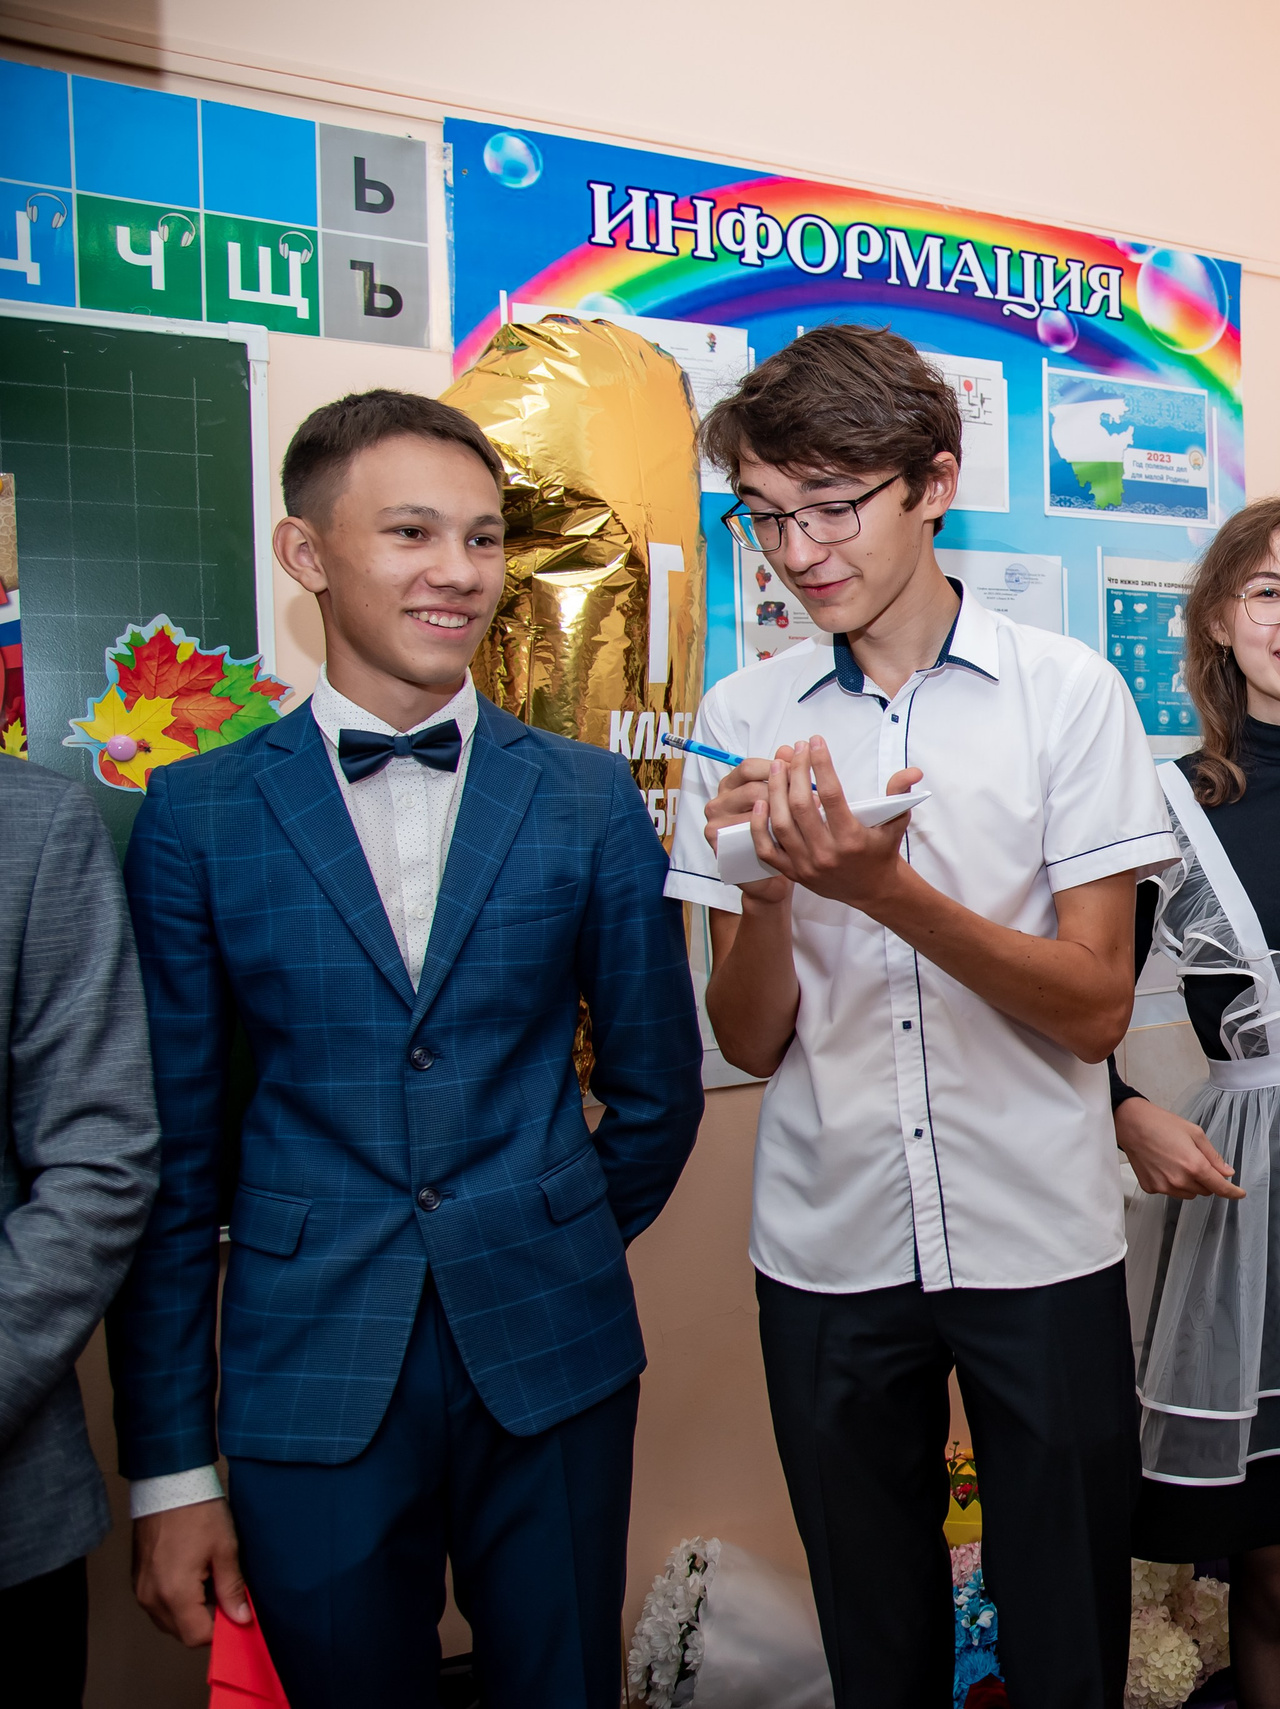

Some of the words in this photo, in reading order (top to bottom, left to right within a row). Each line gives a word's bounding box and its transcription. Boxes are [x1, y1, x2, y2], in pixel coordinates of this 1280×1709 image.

[354, 156, 395, 214] Ь
[587, 180, 1124, 320] ИНФОРМАЦИЯ
[116, 225, 165, 291] Ч
[227, 241, 309, 319] Щ
[350, 259, 403, 318] Ъ
[1132, 460, 1144, 469] Год
[1146, 452, 1172, 463] 2023
[1131, 472, 1143, 480] для
[1144, 473, 1164, 481] малой
[1165, 475, 1189, 484] Родины
